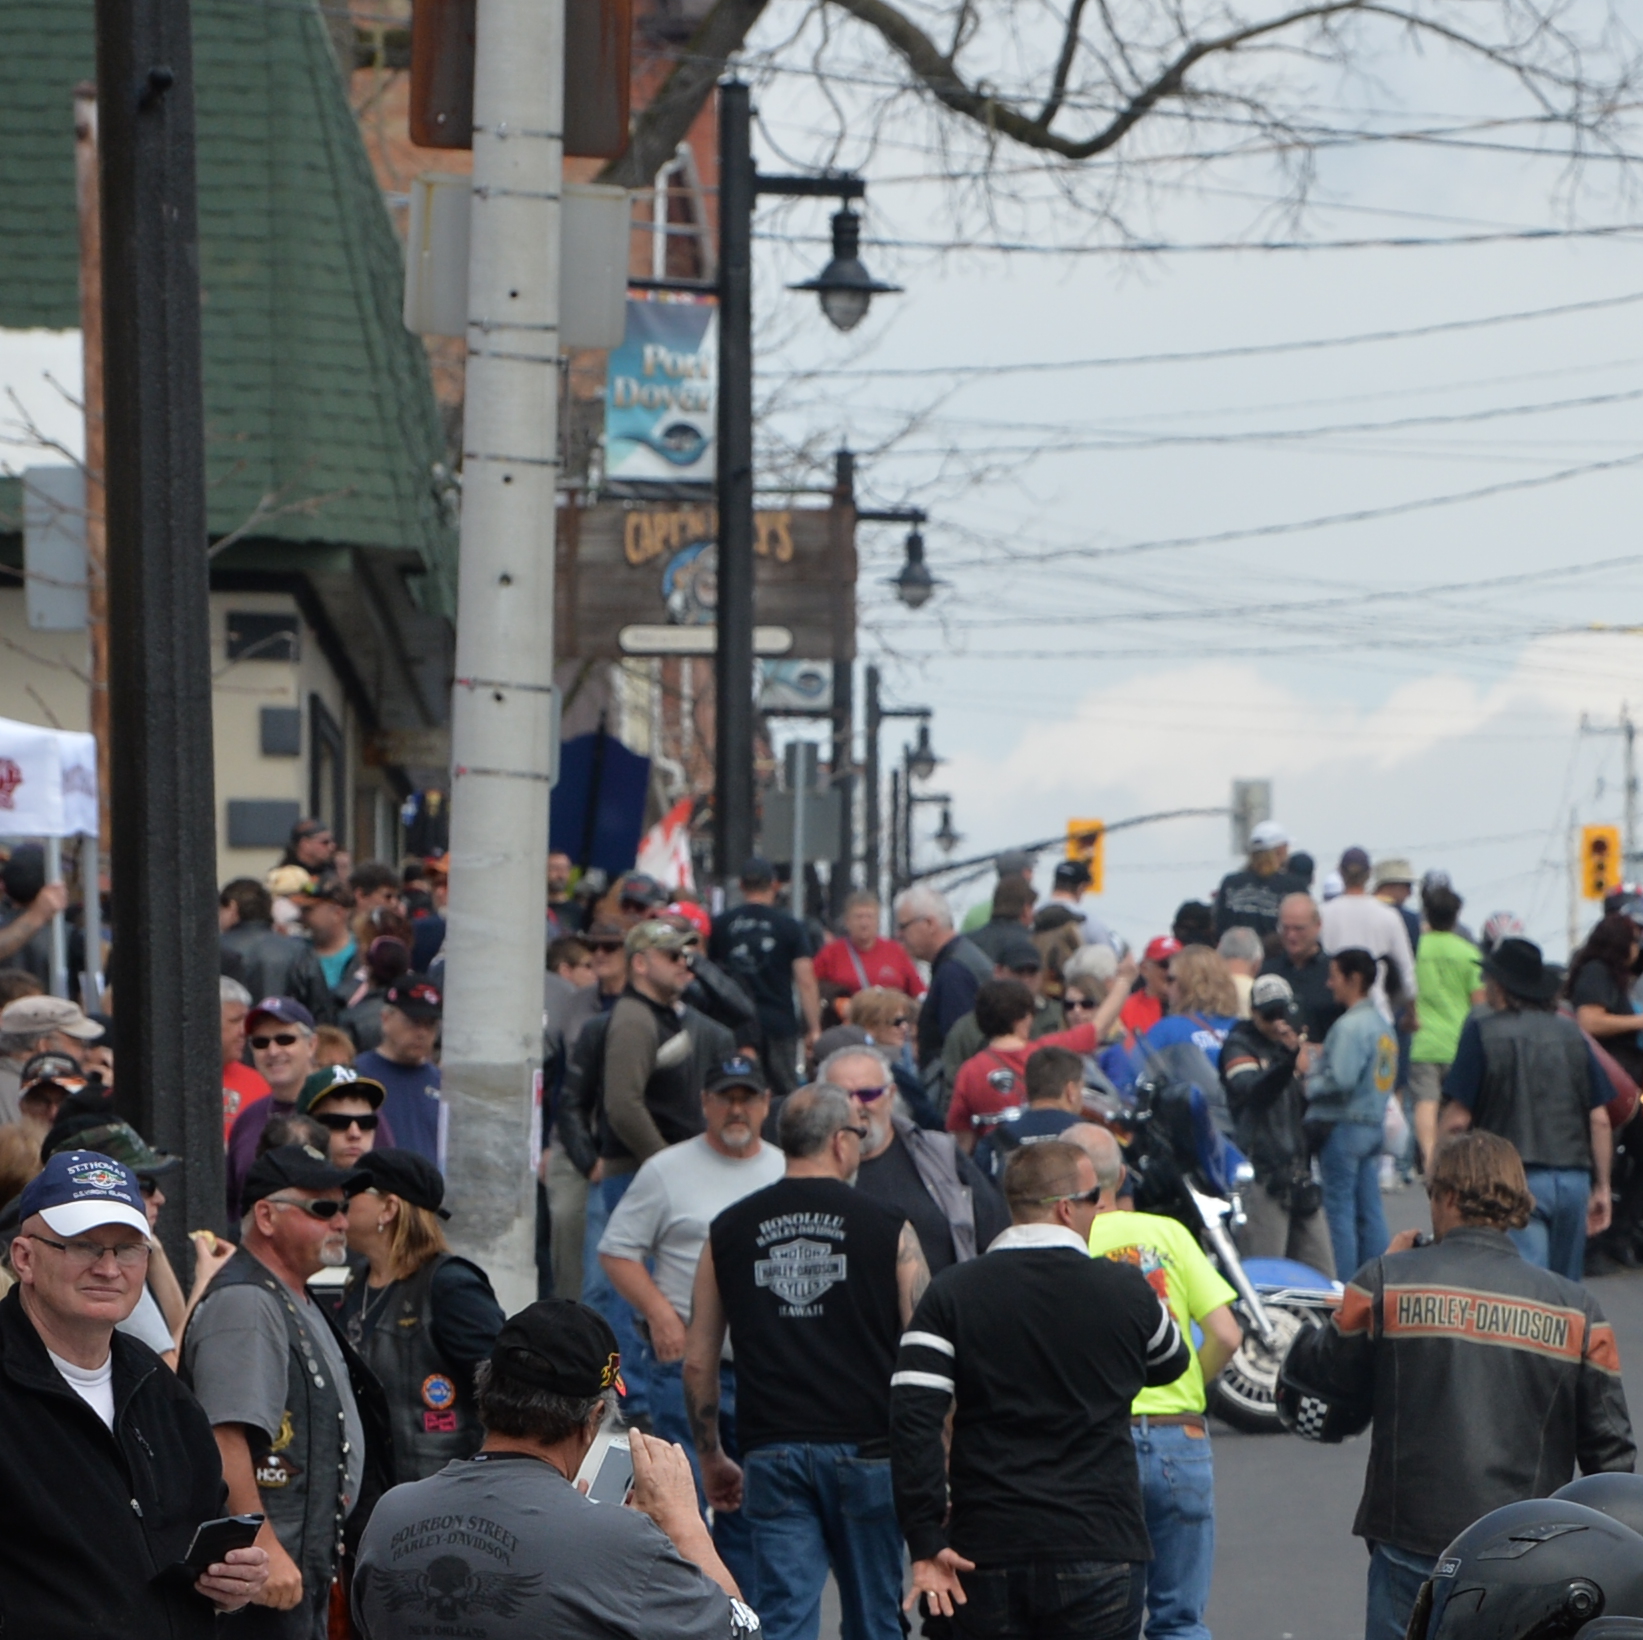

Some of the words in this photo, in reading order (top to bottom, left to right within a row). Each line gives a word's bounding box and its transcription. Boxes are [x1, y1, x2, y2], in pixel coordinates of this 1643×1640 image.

[642, 343, 711, 380] Port
[613, 375, 710, 412] Dover
[758, 1212, 845, 1235] HONOLULU
[778, 1304, 824, 1317] HAWAII
[1398, 1294, 1569, 1347] HARLEY-DAVIDSON
[256, 1467, 287, 1482] HOG
[390, 1515, 464, 1550] BOURBON
[467, 1515, 520, 1552] STREET
[392, 1531, 511, 1567] HARLEY-DAVIDSON
[408, 1625, 433, 1636] NEW
[434, 1625, 488, 1639] ORLEANS
